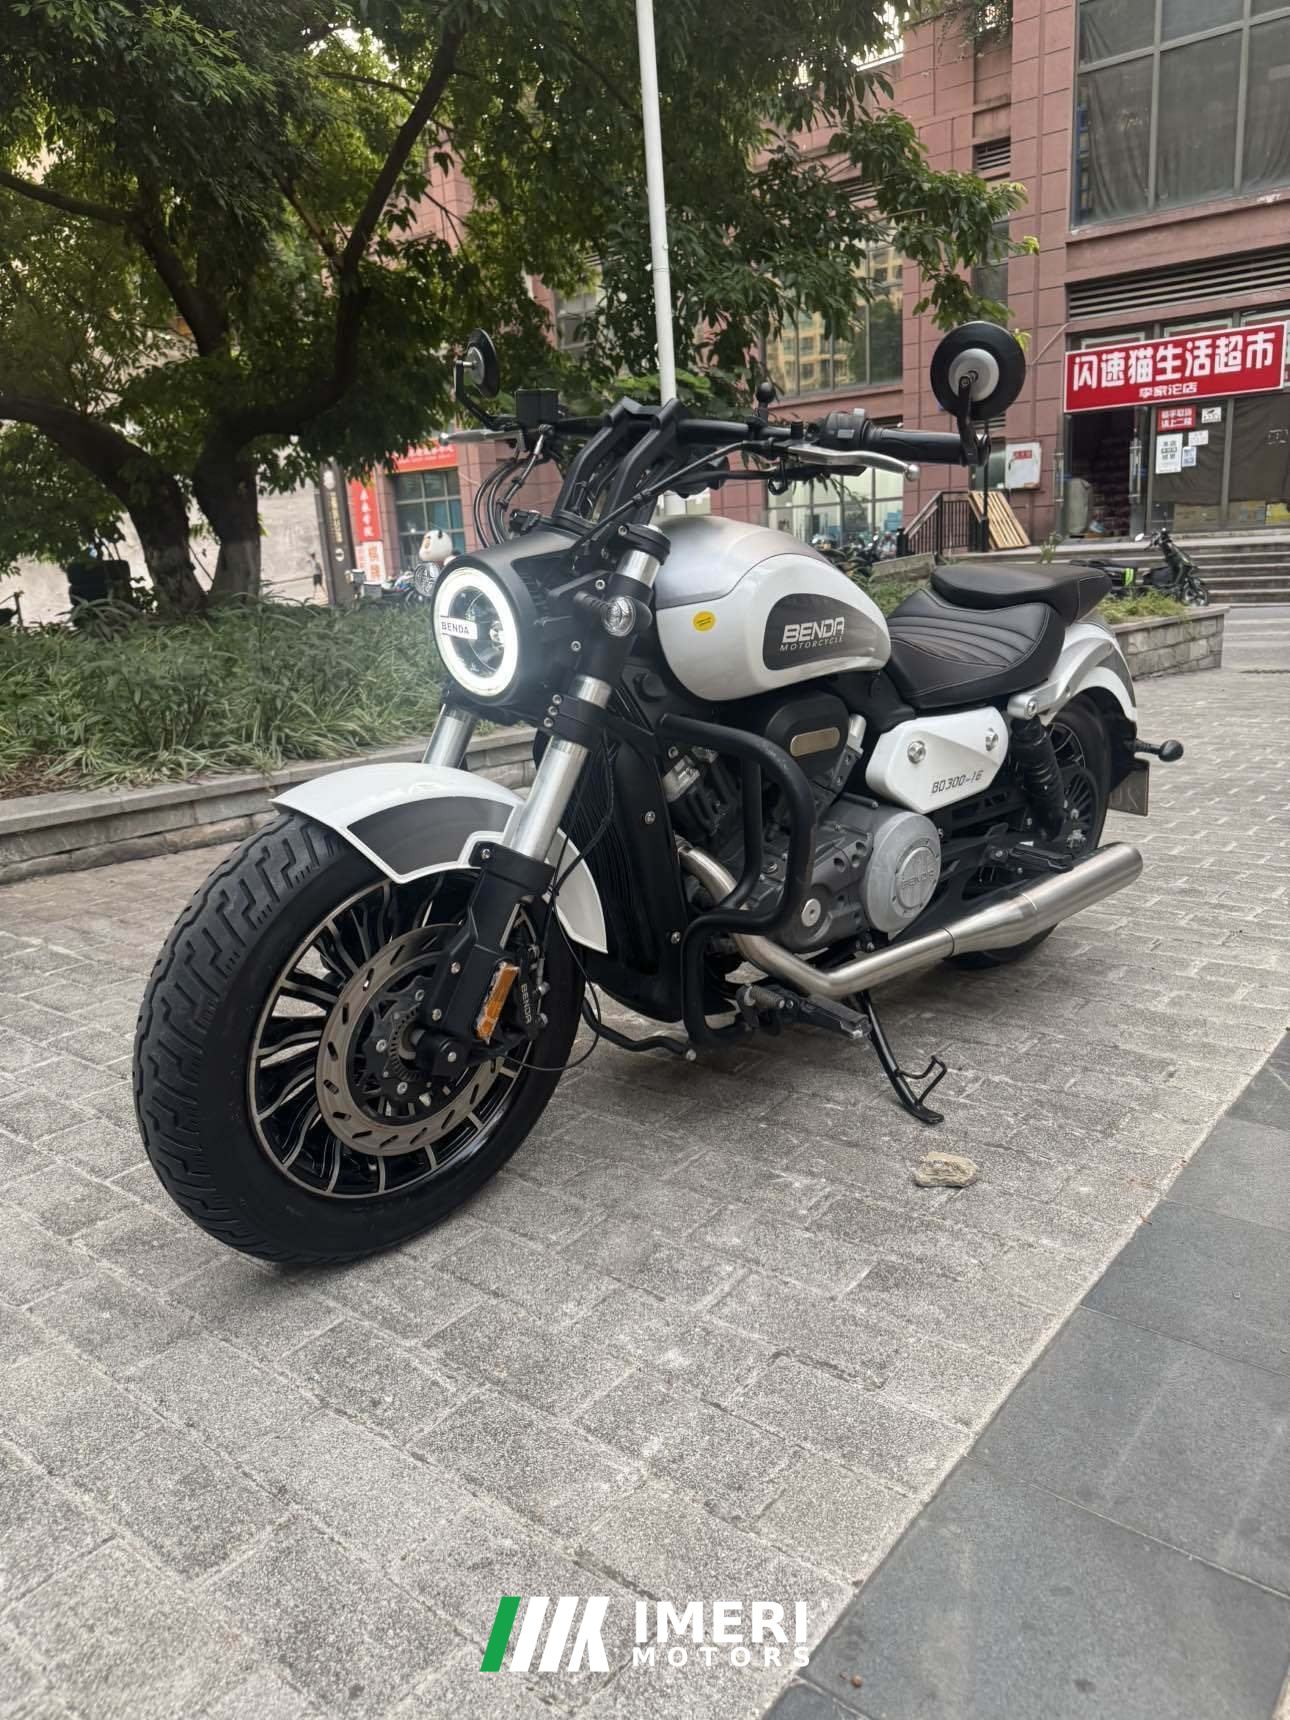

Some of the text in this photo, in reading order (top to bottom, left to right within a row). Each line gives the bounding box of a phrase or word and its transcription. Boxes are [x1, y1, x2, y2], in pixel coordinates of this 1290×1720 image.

[1073, 331, 1276, 391] 闪速猫生活超市
[441, 621, 469, 635] BENDA
[782, 616, 845, 643] BENDA
[520, 983, 532, 1024] BENDA
